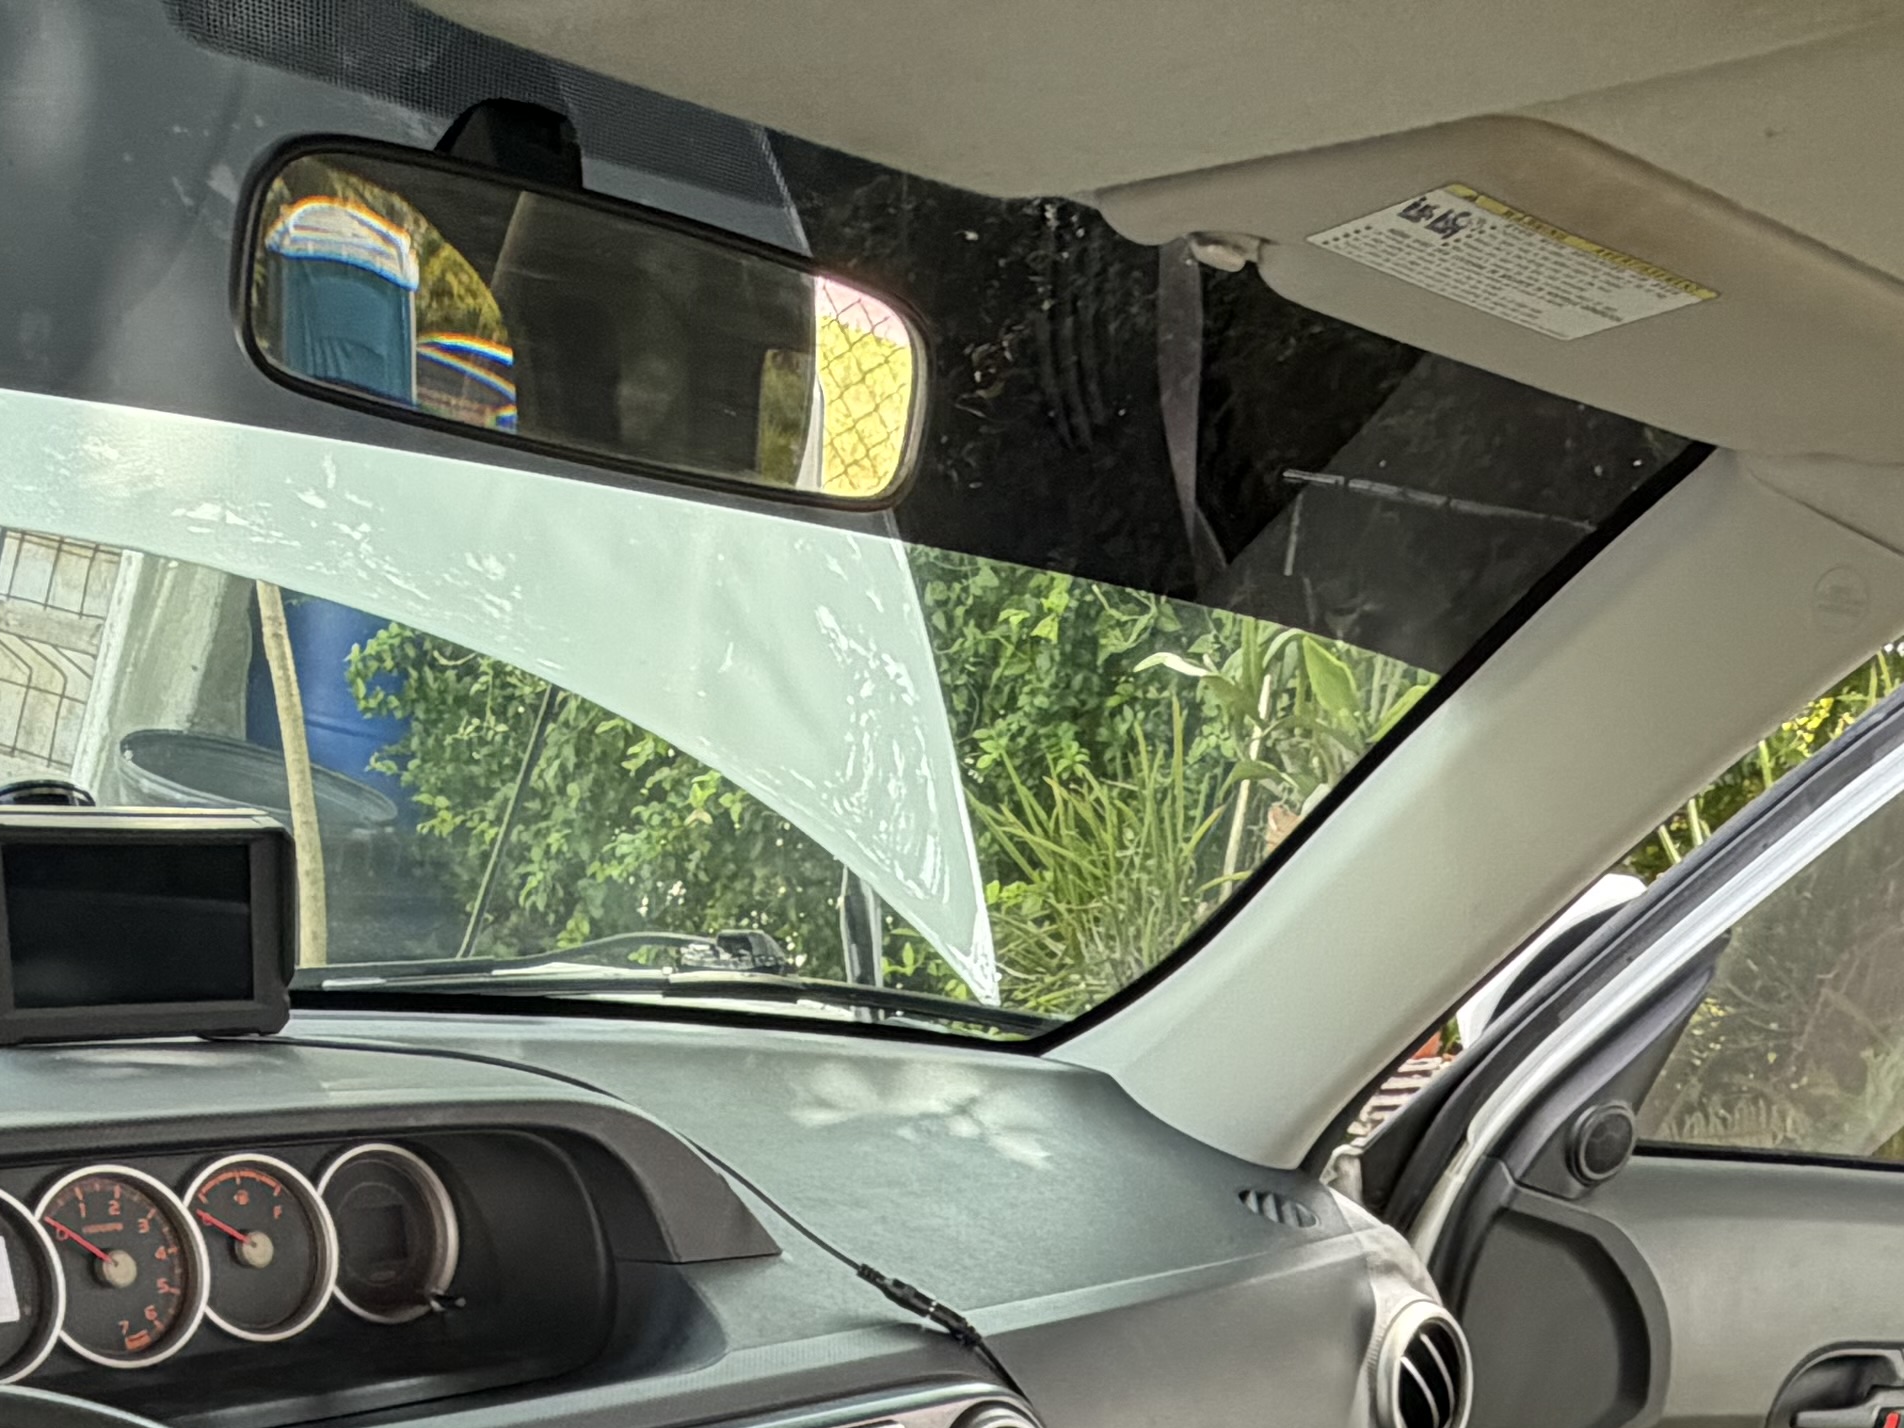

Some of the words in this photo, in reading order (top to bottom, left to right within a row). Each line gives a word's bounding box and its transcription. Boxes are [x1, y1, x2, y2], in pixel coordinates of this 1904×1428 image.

[79, 1202, 86, 1218] 1
[108, 1200, 121, 1216] 2
[137, 1218, 150, 1234] 3
[156, 1278, 170, 1294] 5
[118, 1320, 130, 1335] 7
